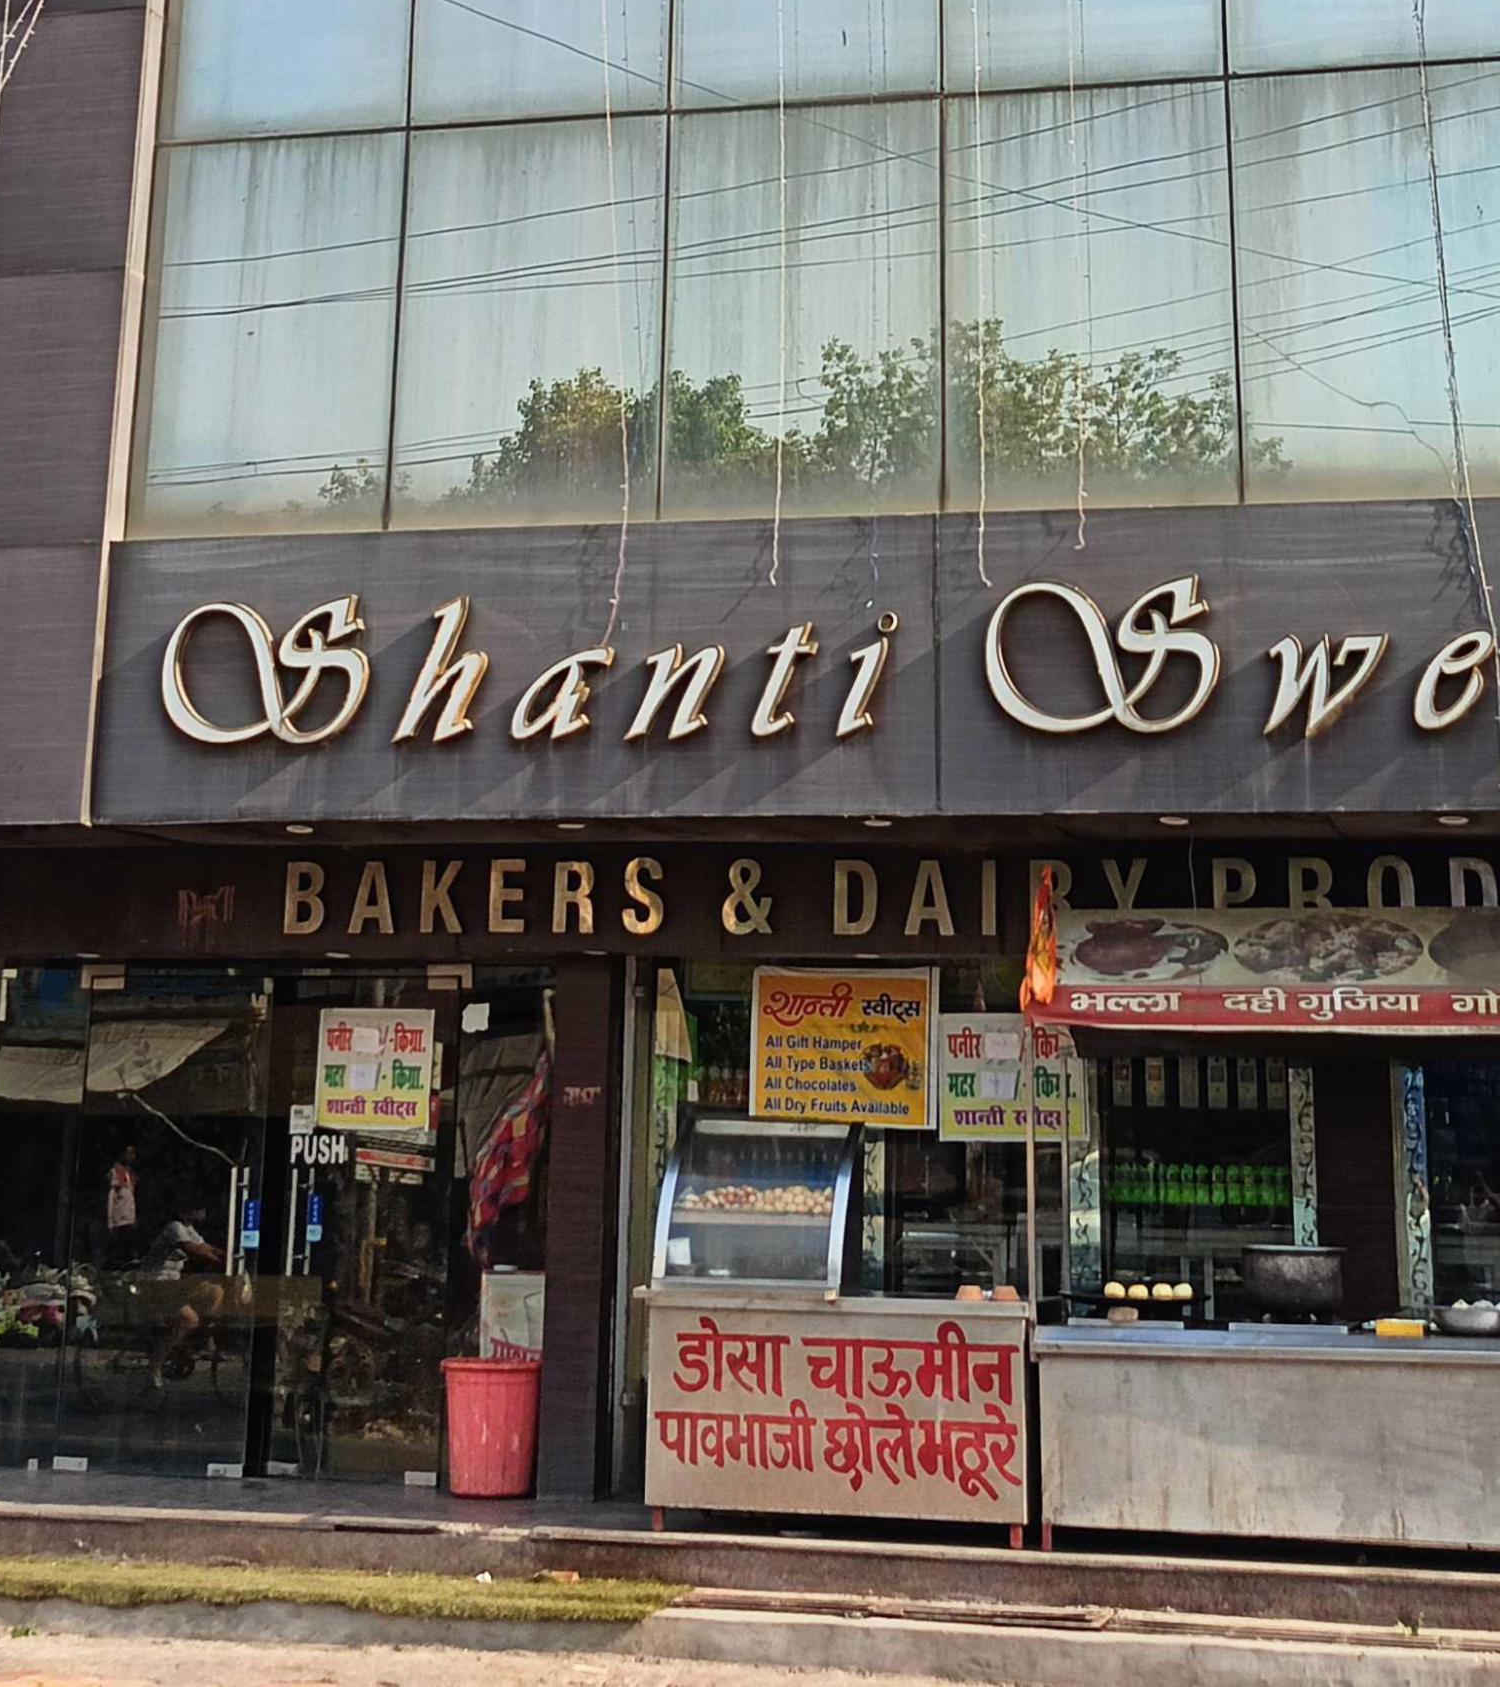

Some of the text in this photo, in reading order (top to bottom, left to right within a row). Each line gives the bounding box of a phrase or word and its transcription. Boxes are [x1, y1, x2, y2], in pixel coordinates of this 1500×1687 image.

[161, 593, 898, 744] Shanti
[283, 856, 665, 936] BAKERS
[721, 857, 773, 936] &
[763, 982, 921, 1027] शान्ती स्वीट्स
[1070, 990, 1182, 1014] भल्ला
[1223, 988, 1288, 1013] दही
[1297, 989, 1421, 1023] गुजिया
[765, 1035, 862, 1052] All Gift Hamper
[765, 1056, 871, 1072] All Type Baskets
[764, 1077, 857, 1092] All Chocolates
[764, 1097, 910, 1115] All Dry Fruits Available
[291, 1134, 345, 1164] PUSH
[673, 1316, 1020, 1406] डोसा चाऊमीन
